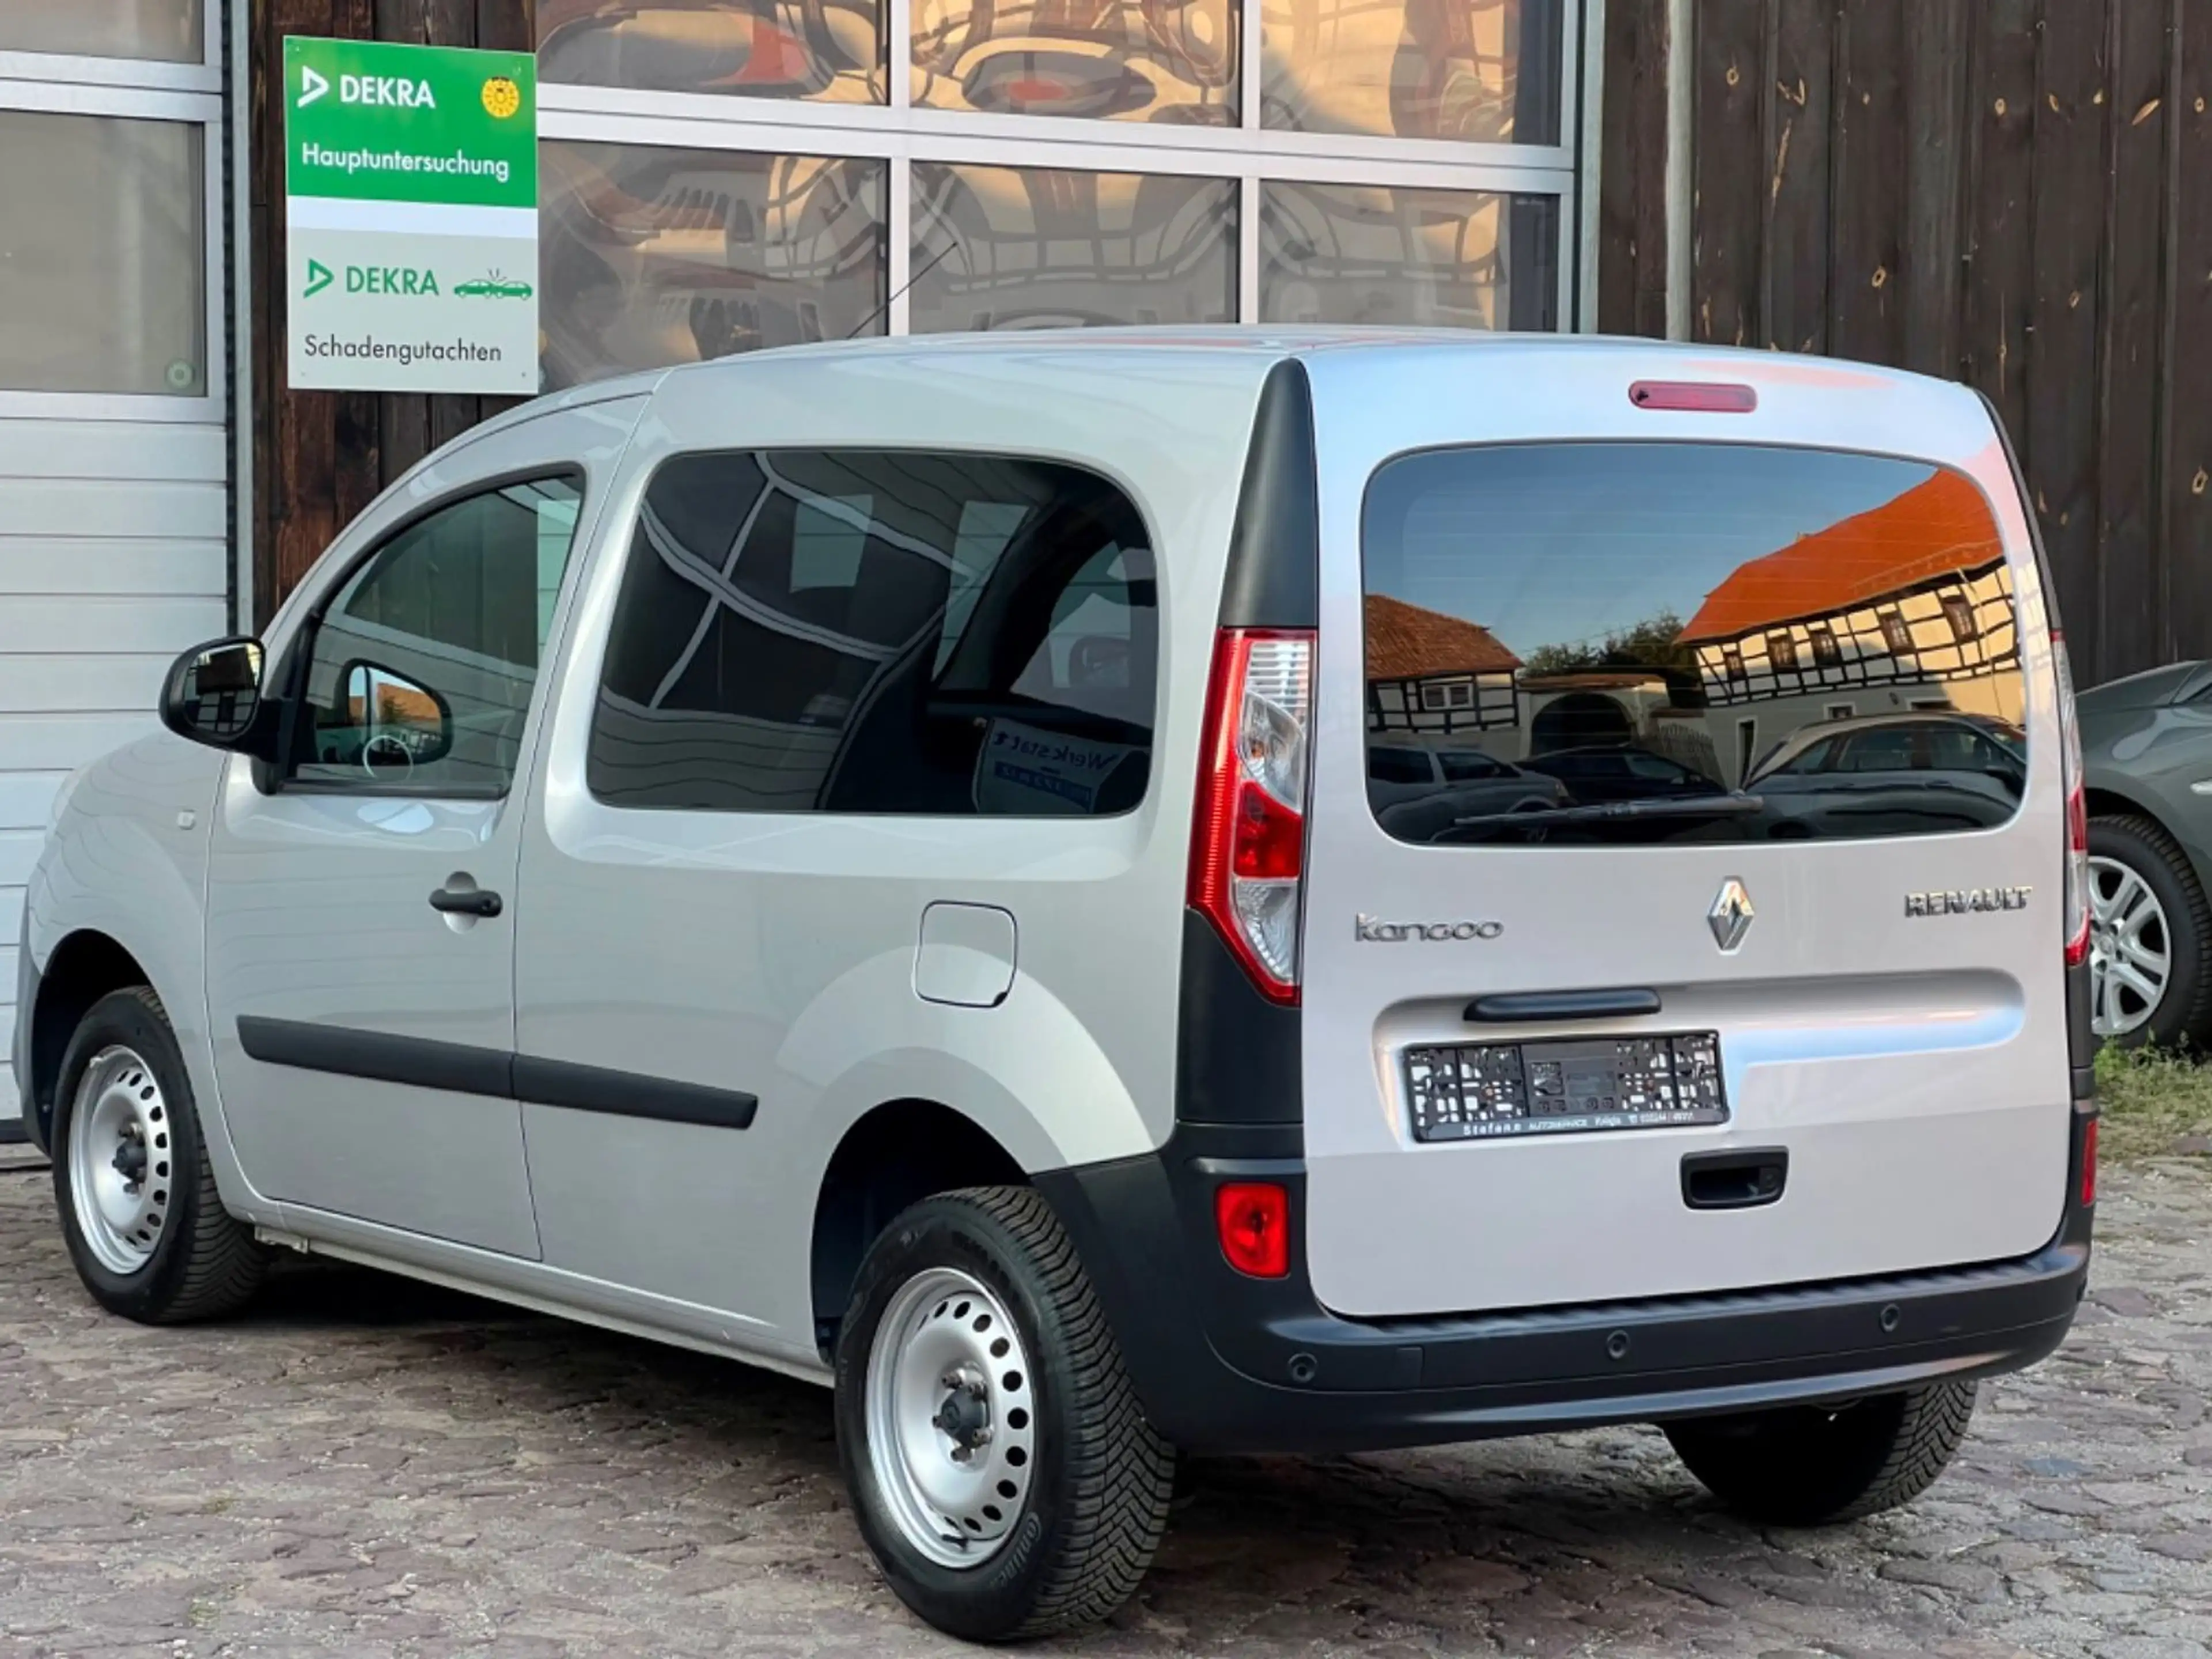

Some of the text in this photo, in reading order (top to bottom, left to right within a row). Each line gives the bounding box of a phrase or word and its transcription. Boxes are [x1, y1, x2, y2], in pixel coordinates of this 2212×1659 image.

[340, 74, 435, 109] DEKRA
[302, 143, 509, 183] Hauptuntersuchung
[346, 266, 440, 296] DEKRA
[305, 334, 502, 365] Schadengutachten
[1904, 886, 2033, 918] RENAULT
